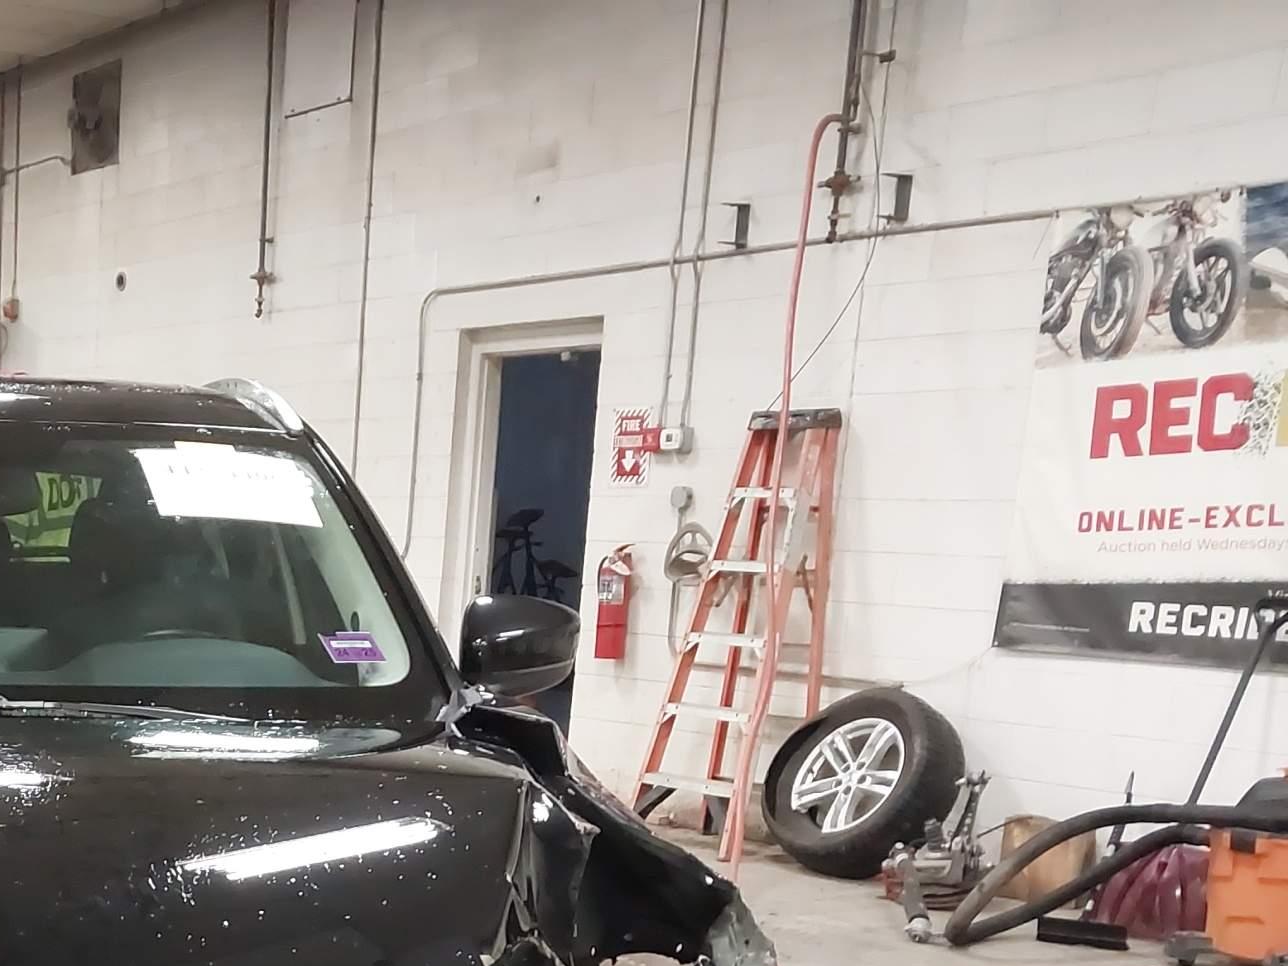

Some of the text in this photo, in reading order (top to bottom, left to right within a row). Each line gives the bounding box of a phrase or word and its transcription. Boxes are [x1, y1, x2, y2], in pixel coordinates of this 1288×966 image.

[622, 419, 642, 432] FIRE
[1078, 504, 1288, 532] ONLINE-EXCL
[1097, 538, 1156, 553] Auction
[1160, 536, 1192, 551] held
